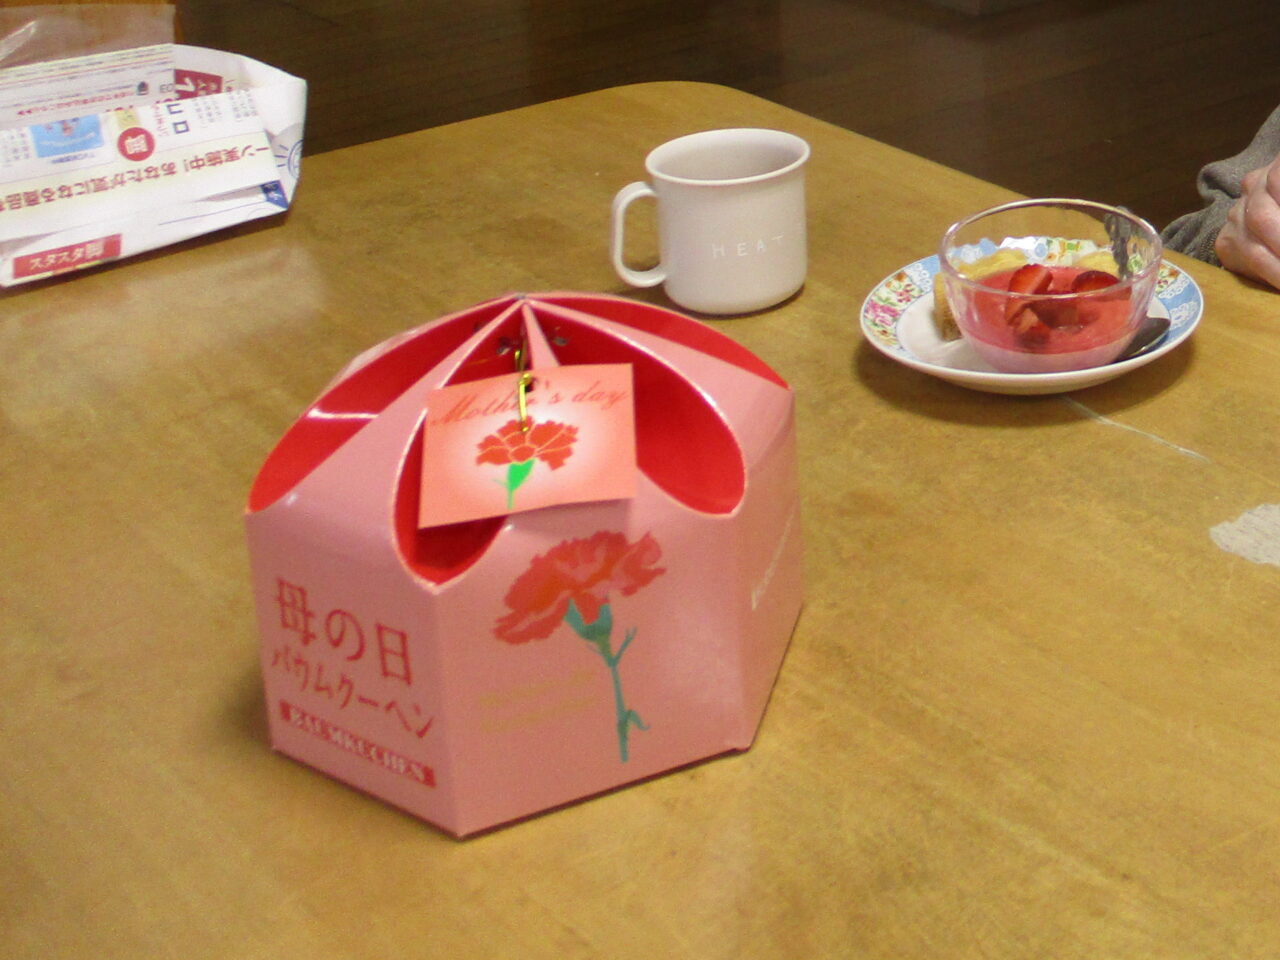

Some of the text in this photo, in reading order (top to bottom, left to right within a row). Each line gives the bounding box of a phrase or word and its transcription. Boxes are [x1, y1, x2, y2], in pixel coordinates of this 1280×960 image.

[0, 161, 178, 212] あなたが気になる商品
[711, 234, 784, 259] HEAT
[572, 381, 628, 410] day
[274, 576, 412, 686] 母の日
[271, 644, 434, 739] バウムクーヘン
